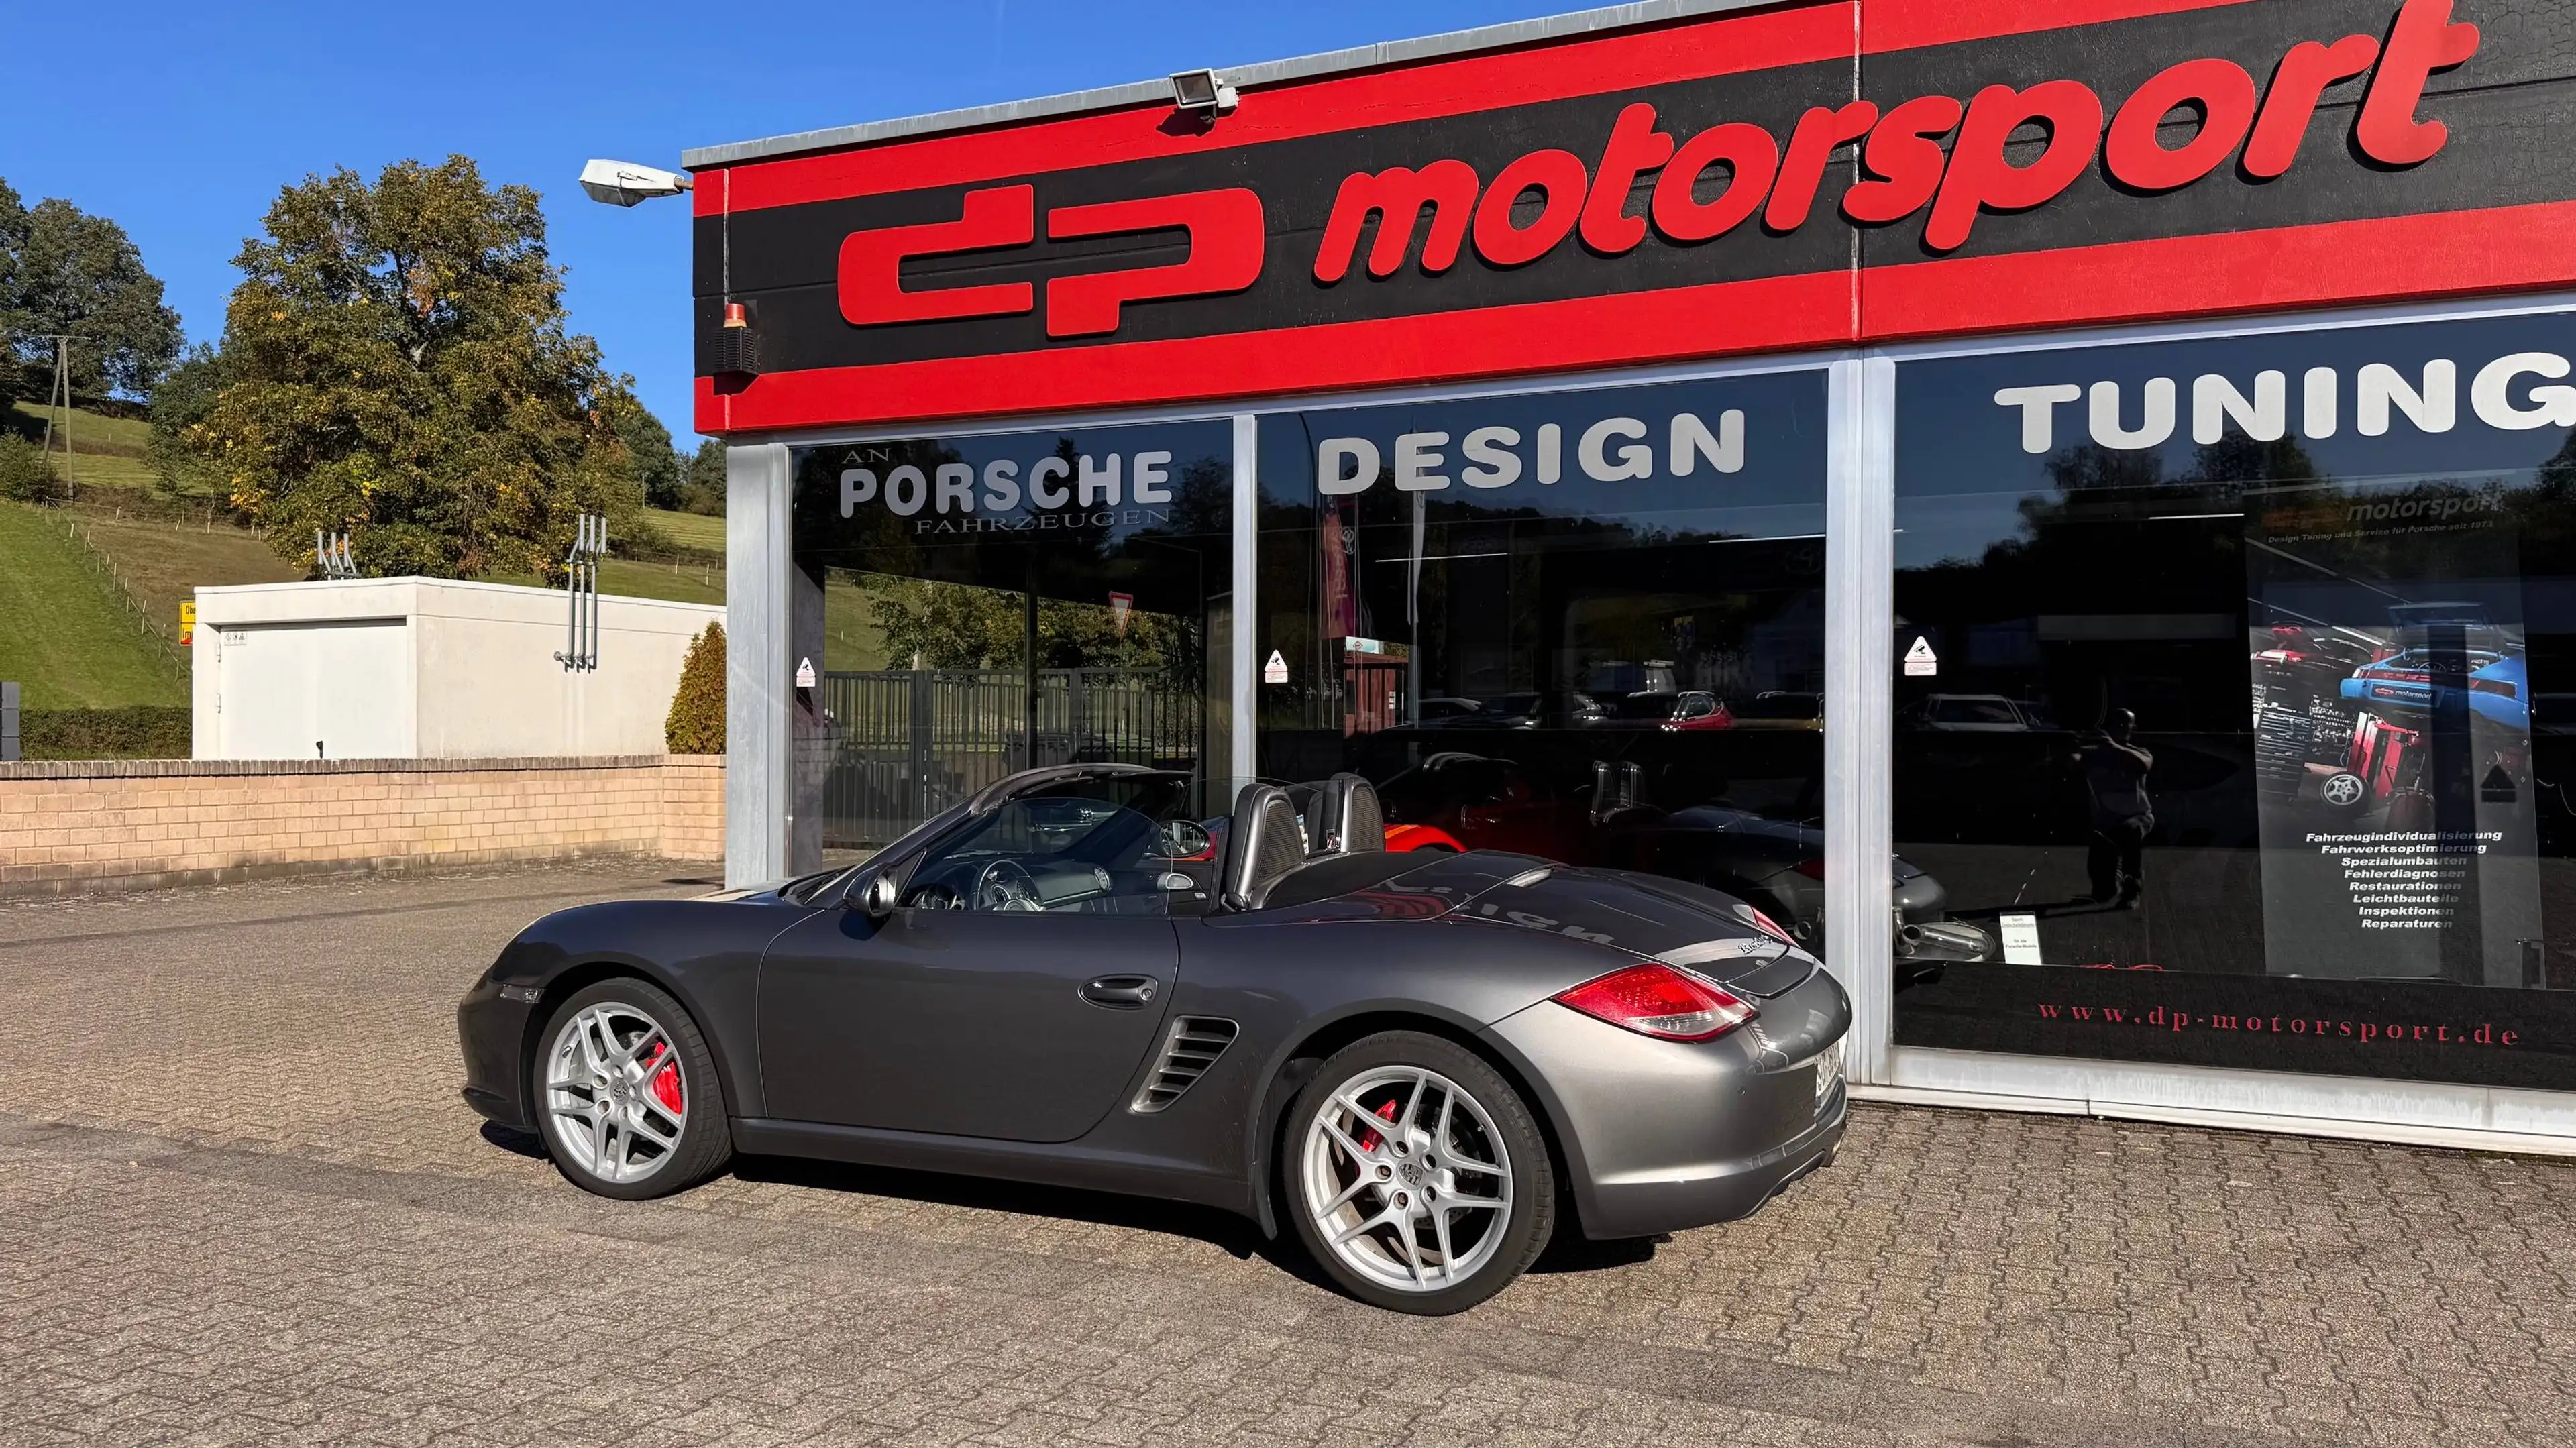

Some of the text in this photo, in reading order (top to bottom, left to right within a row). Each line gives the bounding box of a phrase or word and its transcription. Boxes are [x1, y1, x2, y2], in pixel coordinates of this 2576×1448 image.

[1313, 0, 2480, 283] motorsport
[1994, 352, 2576, 453] TUNING
[841, 448, 892, 464] AN
[1318, 409, 1746, 495] DESIGN
[840, 451, 1173, 518] PORSCHE
[914, 508, 1171, 535] FAHRZEUGEN
[2306, 831, 2502, 843] Fahrzeugindividualisierung
[2321, 844, 2487, 854] Fahrwerksoptimierung
[2341, 856, 2467, 867] Spezialumbauten
[2344, 869, 2465, 879] Fehlerdiagnosen
[2349, 881, 2462, 891] Restaurationen
[2353, 894, 2459, 903] Leichtbauteile
[2359, 906, 2454, 917] Inspektionen
[2361, 919, 2453, 930] Reparaturen
[2039, 1002, 2519, 1046] www.dp-motorsport.de
